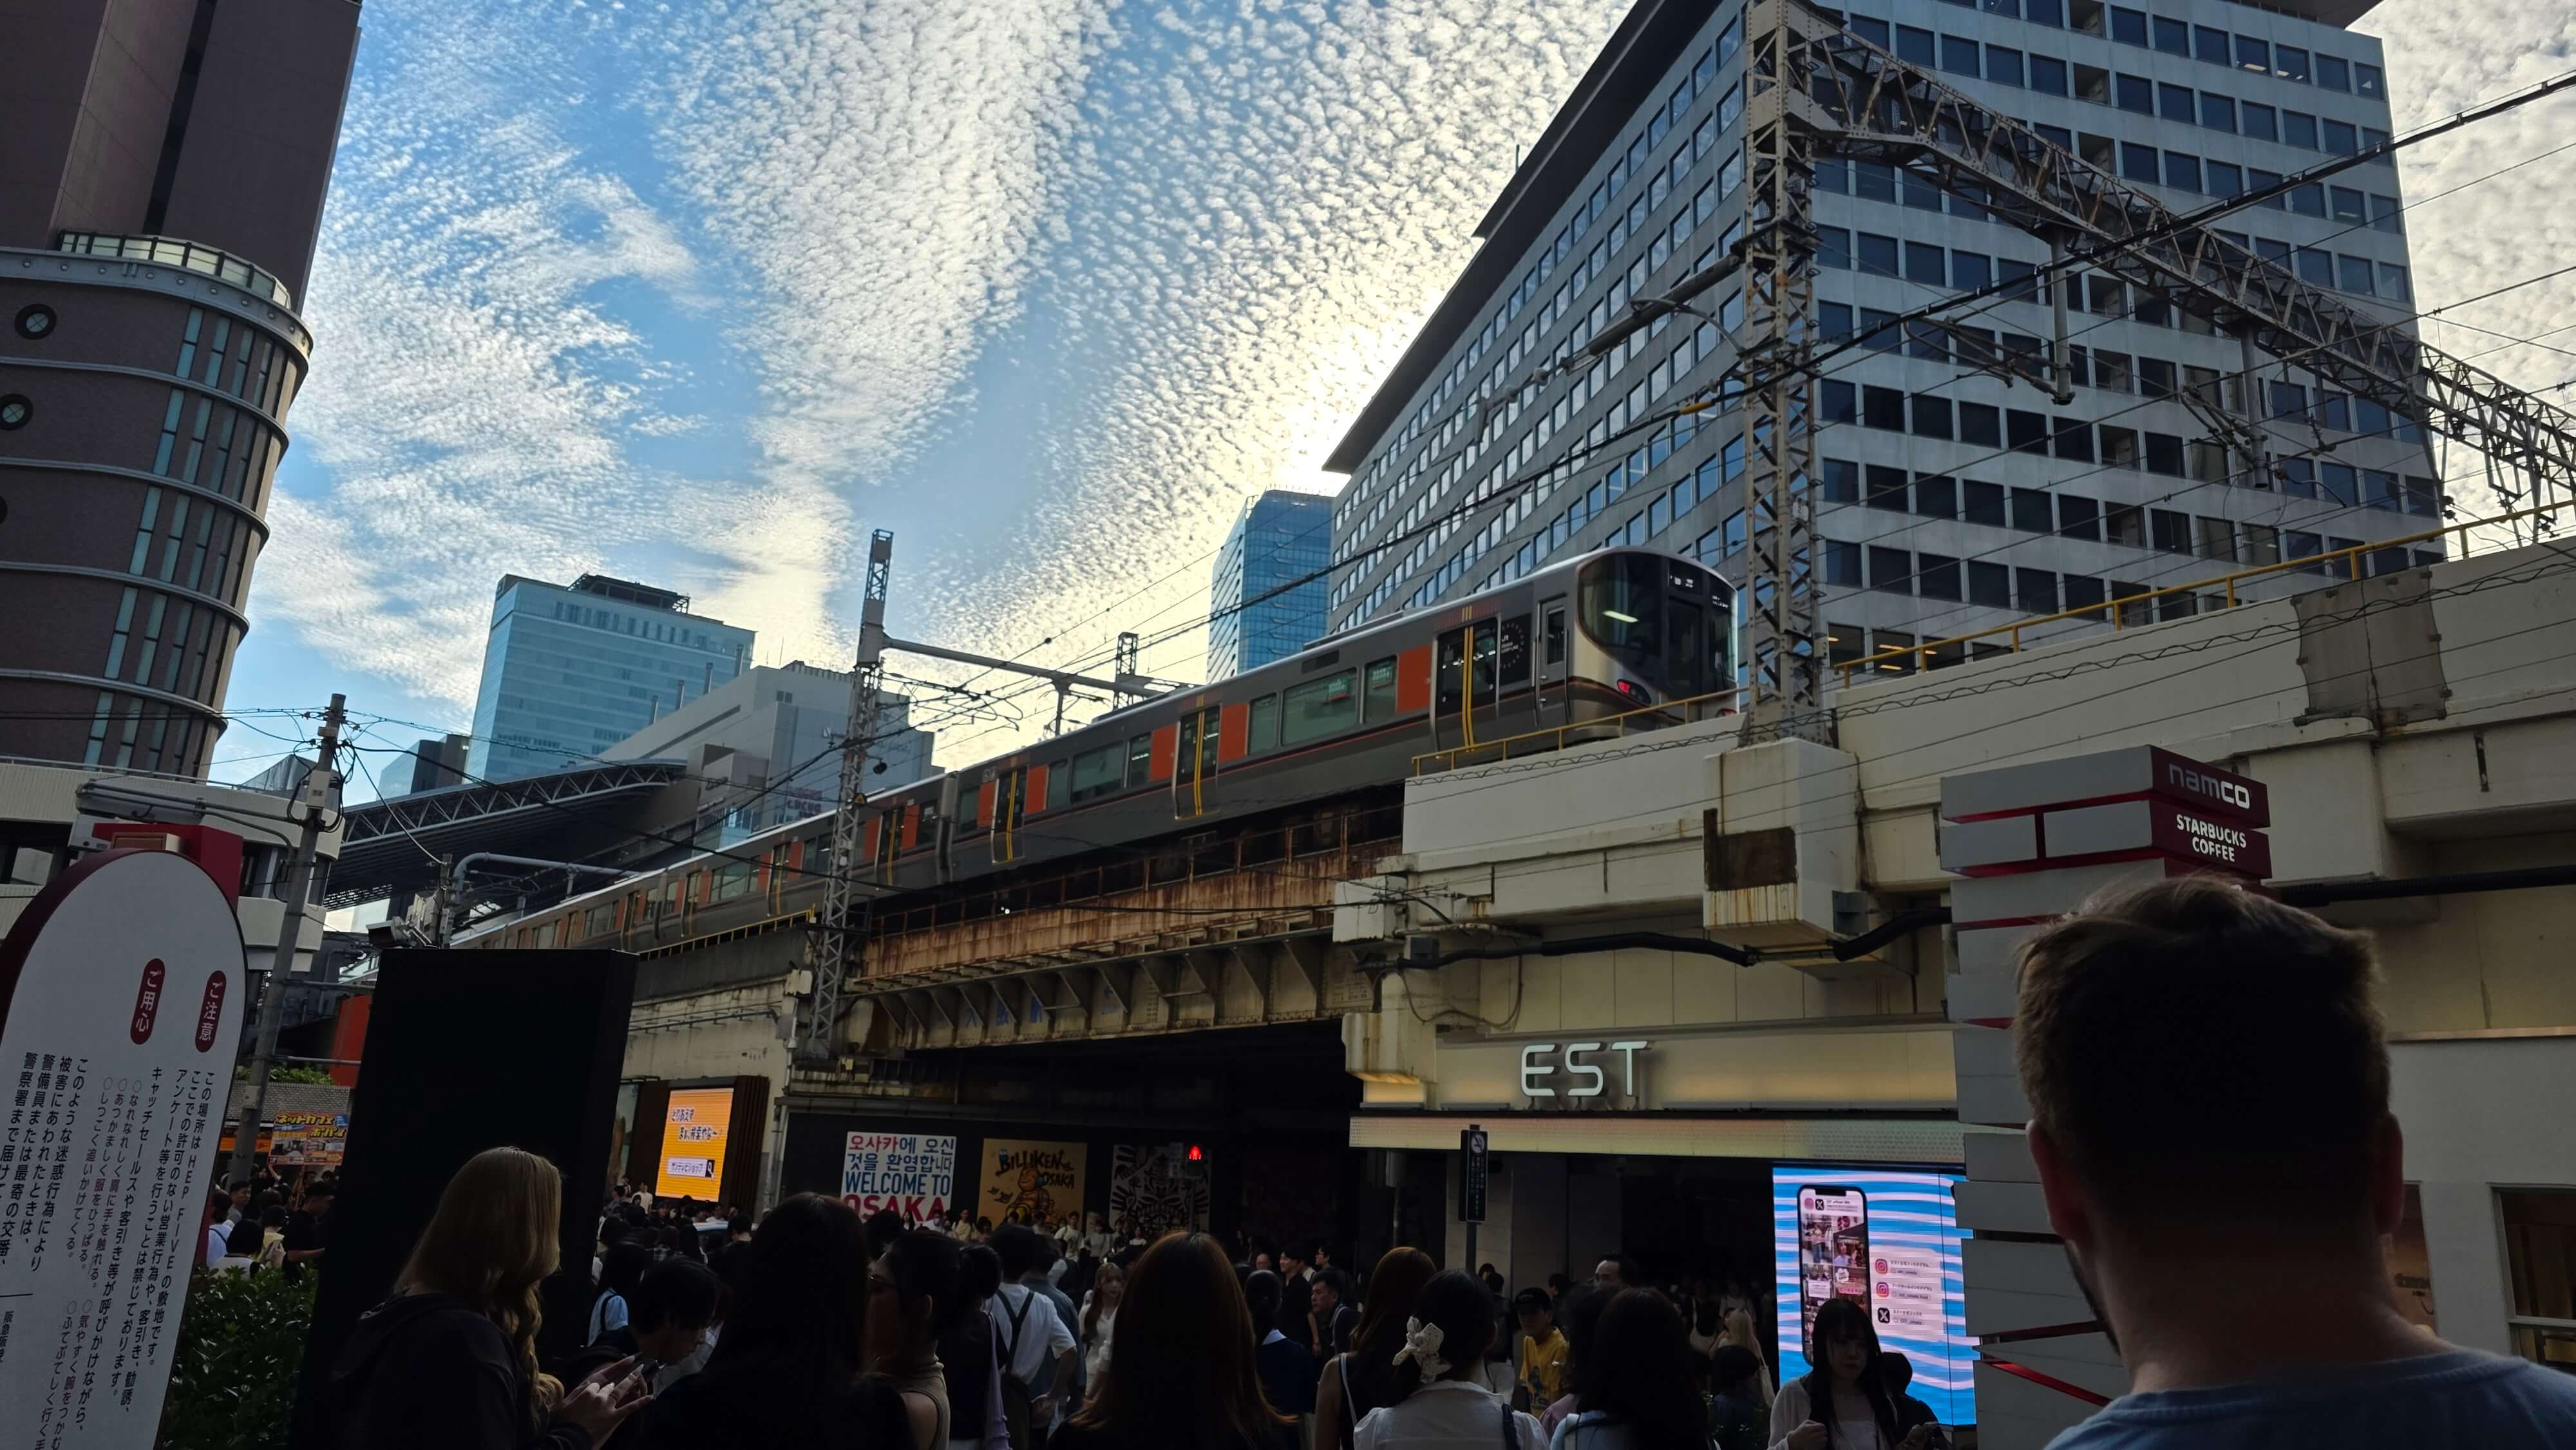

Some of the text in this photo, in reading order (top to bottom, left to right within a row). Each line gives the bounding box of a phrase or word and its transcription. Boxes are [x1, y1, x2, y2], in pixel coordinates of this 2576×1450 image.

[2168, 763, 2250, 809] namco
[2176, 813, 2247, 849] STARBUCKS
[2192, 836, 2235, 862] COFFEE
[135, 970, 162, 1032] ご用心
[199, 981, 223, 1041] ご注意
[1521, 1041, 1648, 1097] EST
[277, 1114, 335, 1125] ネットカフェ
[308, 1127, 346, 1138] ポパイ
[20, 1055, 73, 1245] 被害にあわれたときは、
[847, 1153, 952, 1174] 것을 환영합니다
[848, 1135, 955, 1156] 오사카에 오신
[32, 1059, 88, 1272] このような迷惑行為により
[845, 1171, 951, 1196] WELCOME TO
